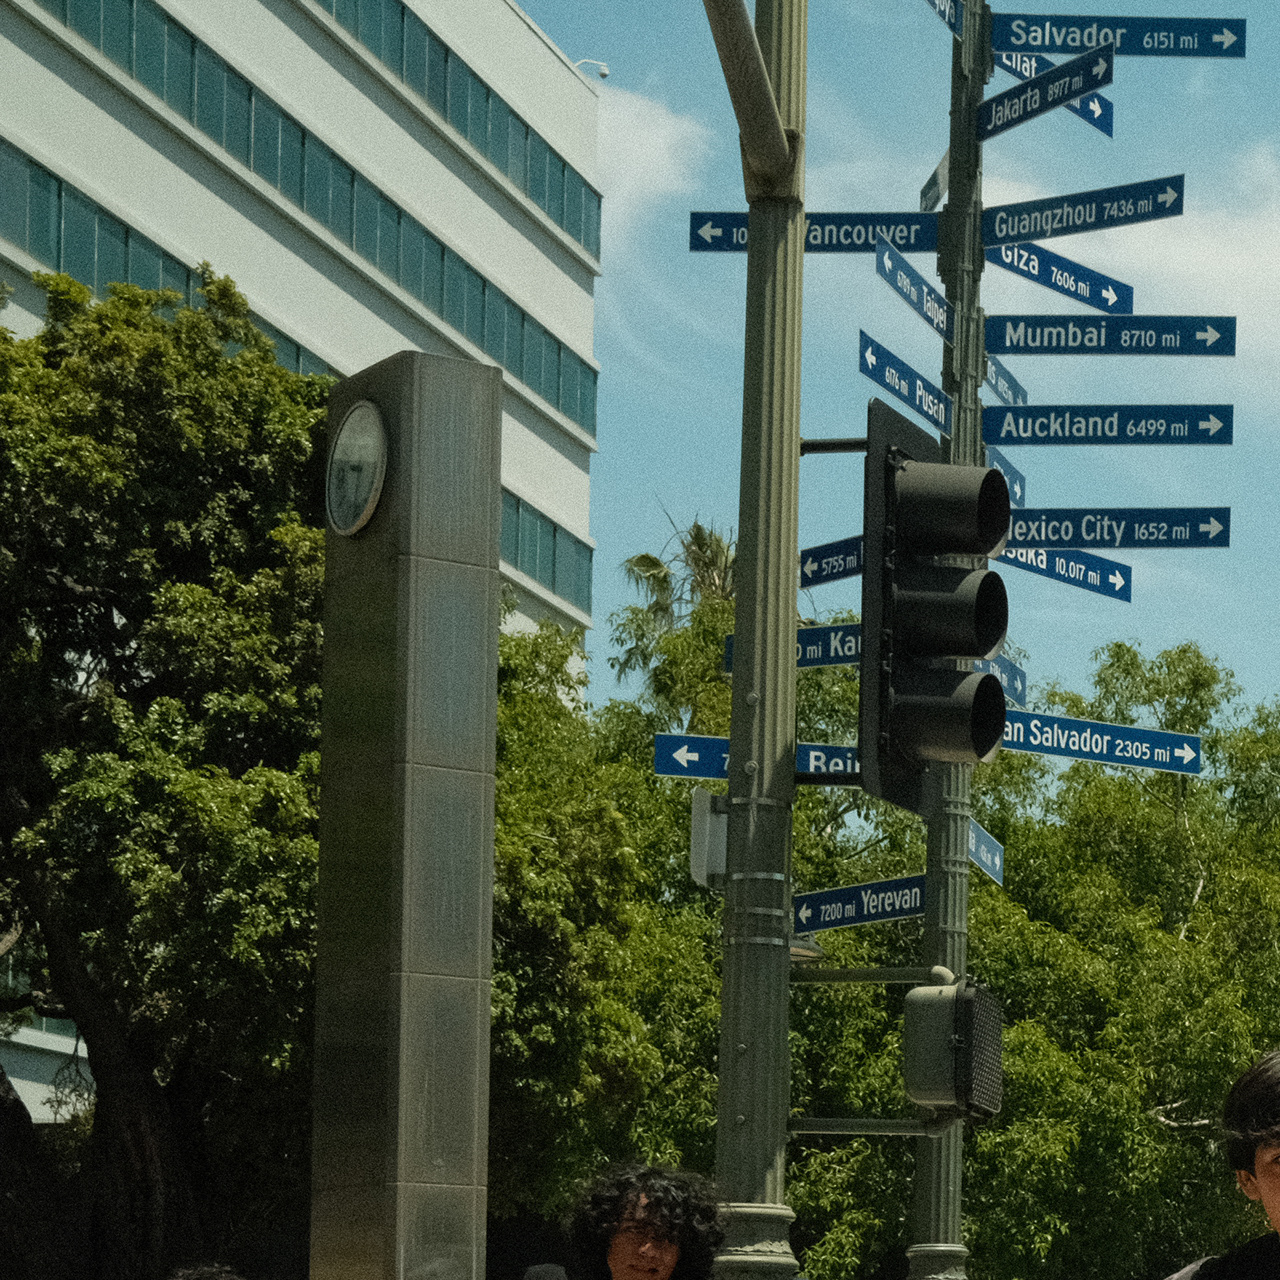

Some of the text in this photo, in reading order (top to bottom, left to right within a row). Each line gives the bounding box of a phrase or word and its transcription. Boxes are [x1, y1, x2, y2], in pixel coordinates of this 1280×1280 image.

[1010, 19, 1198, 49] Salvador 6151 mi
[986, 87, 1041, 131] Jakarta
[1048, 74, 1071, 102] 8977
[1072, 71, 1083, 92] mi
[803, 219, 921, 245] ancouver
[994, 195, 1152, 239] Guangzhou 7436 mi
[1001, 243, 1090, 299] Giza 7606 mi
[922, 284, 948, 332] Taipei
[1005, 320, 1181, 347] Mumbai 8710 mi
[916, 378, 945, 426] Pusan
[1000, 411, 1189, 438] Auckland 6499 mi
[1081, 514, 1126, 547] City
[1134, 522, 1168, 541] 1652
[1172, 522, 1190, 540] mi
[821, 551, 857, 576] 5755 mi
[1055, 556, 1086, 579] 10,017
[1087, 570, 1101, 587] mi
[806, 641, 822, 659] mi
[1003, 719, 1171, 763] an Salvador 2305 mi
[820, 887, 921, 922] 7200 mi Yerevan
